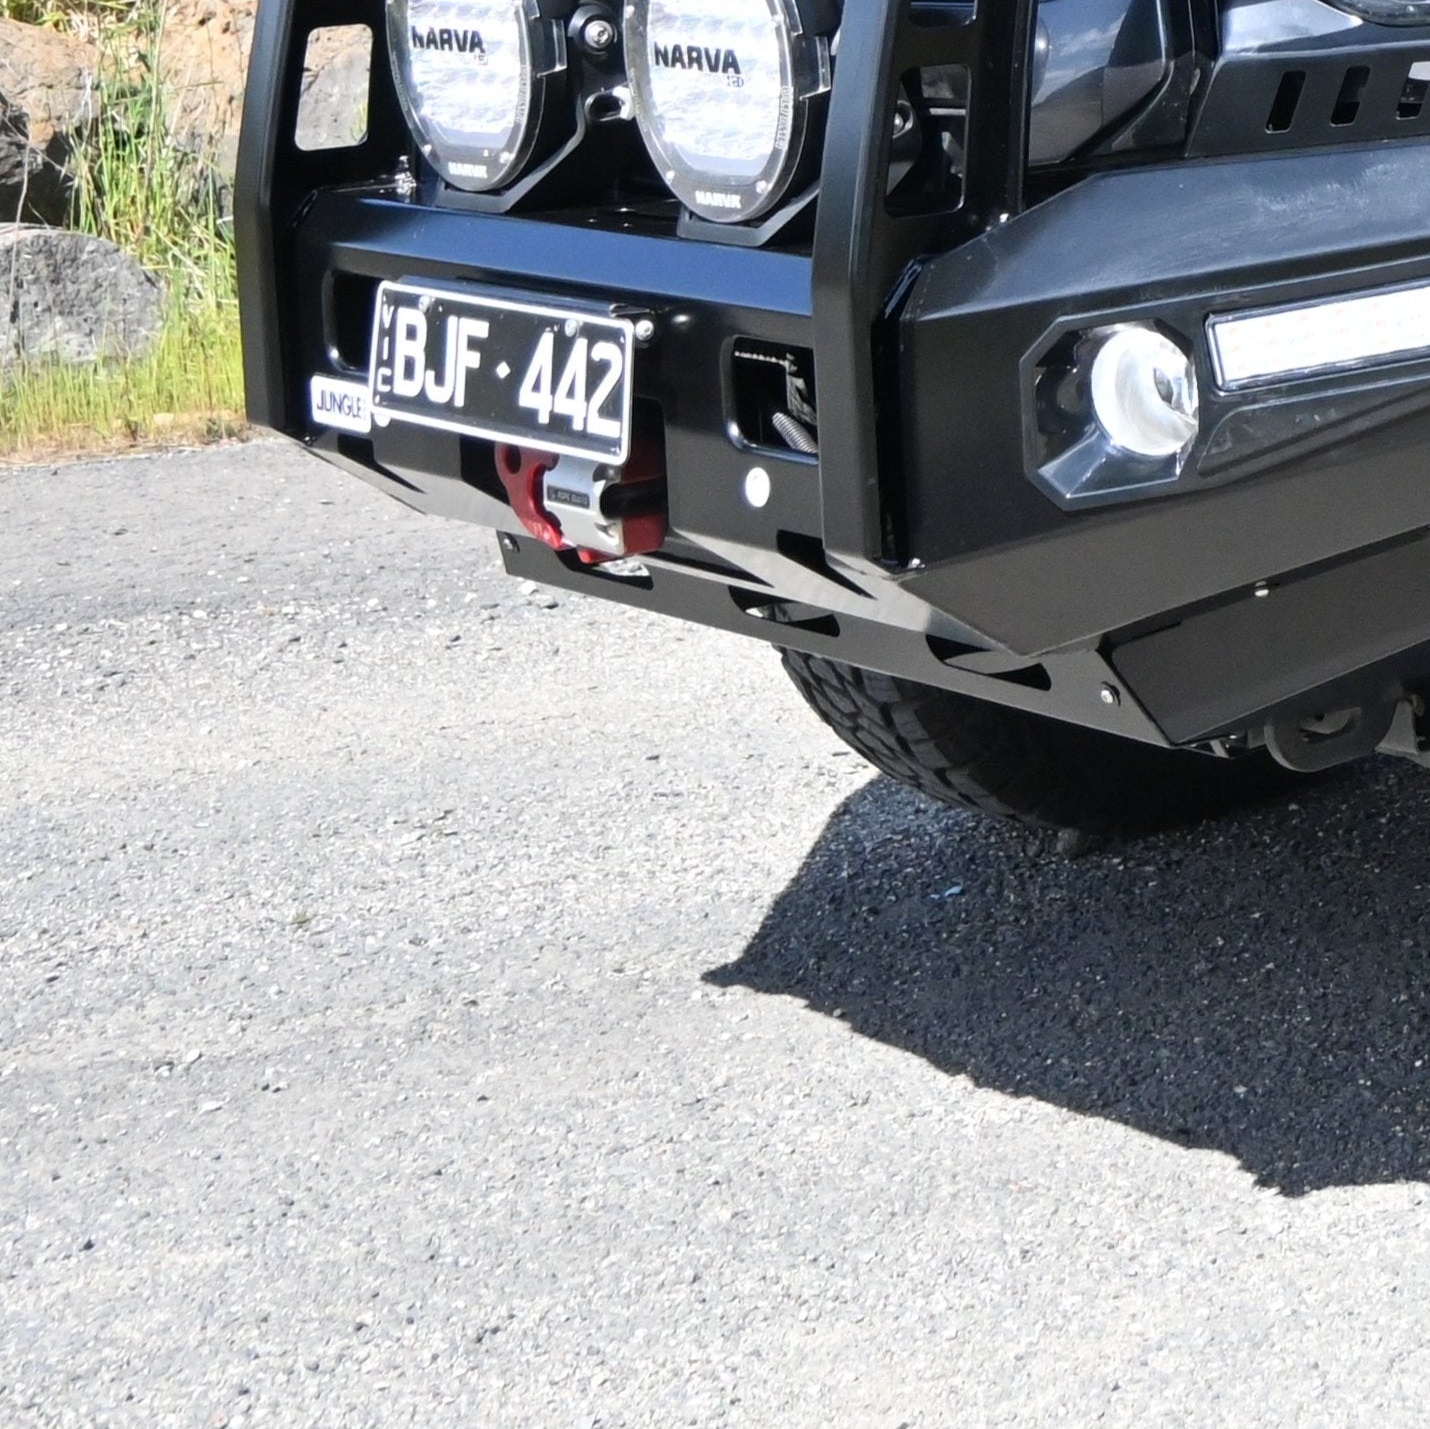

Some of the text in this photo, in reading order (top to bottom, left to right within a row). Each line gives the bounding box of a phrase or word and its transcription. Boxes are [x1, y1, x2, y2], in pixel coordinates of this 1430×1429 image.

[411, 25, 486, 53] NARVA
[654, 42, 741, 74] NARVA
[376, 303, 395, 393] VIC
[393, 306, 623, 438] BJF 442
[316, 389, 363, 419] JUNGLE
